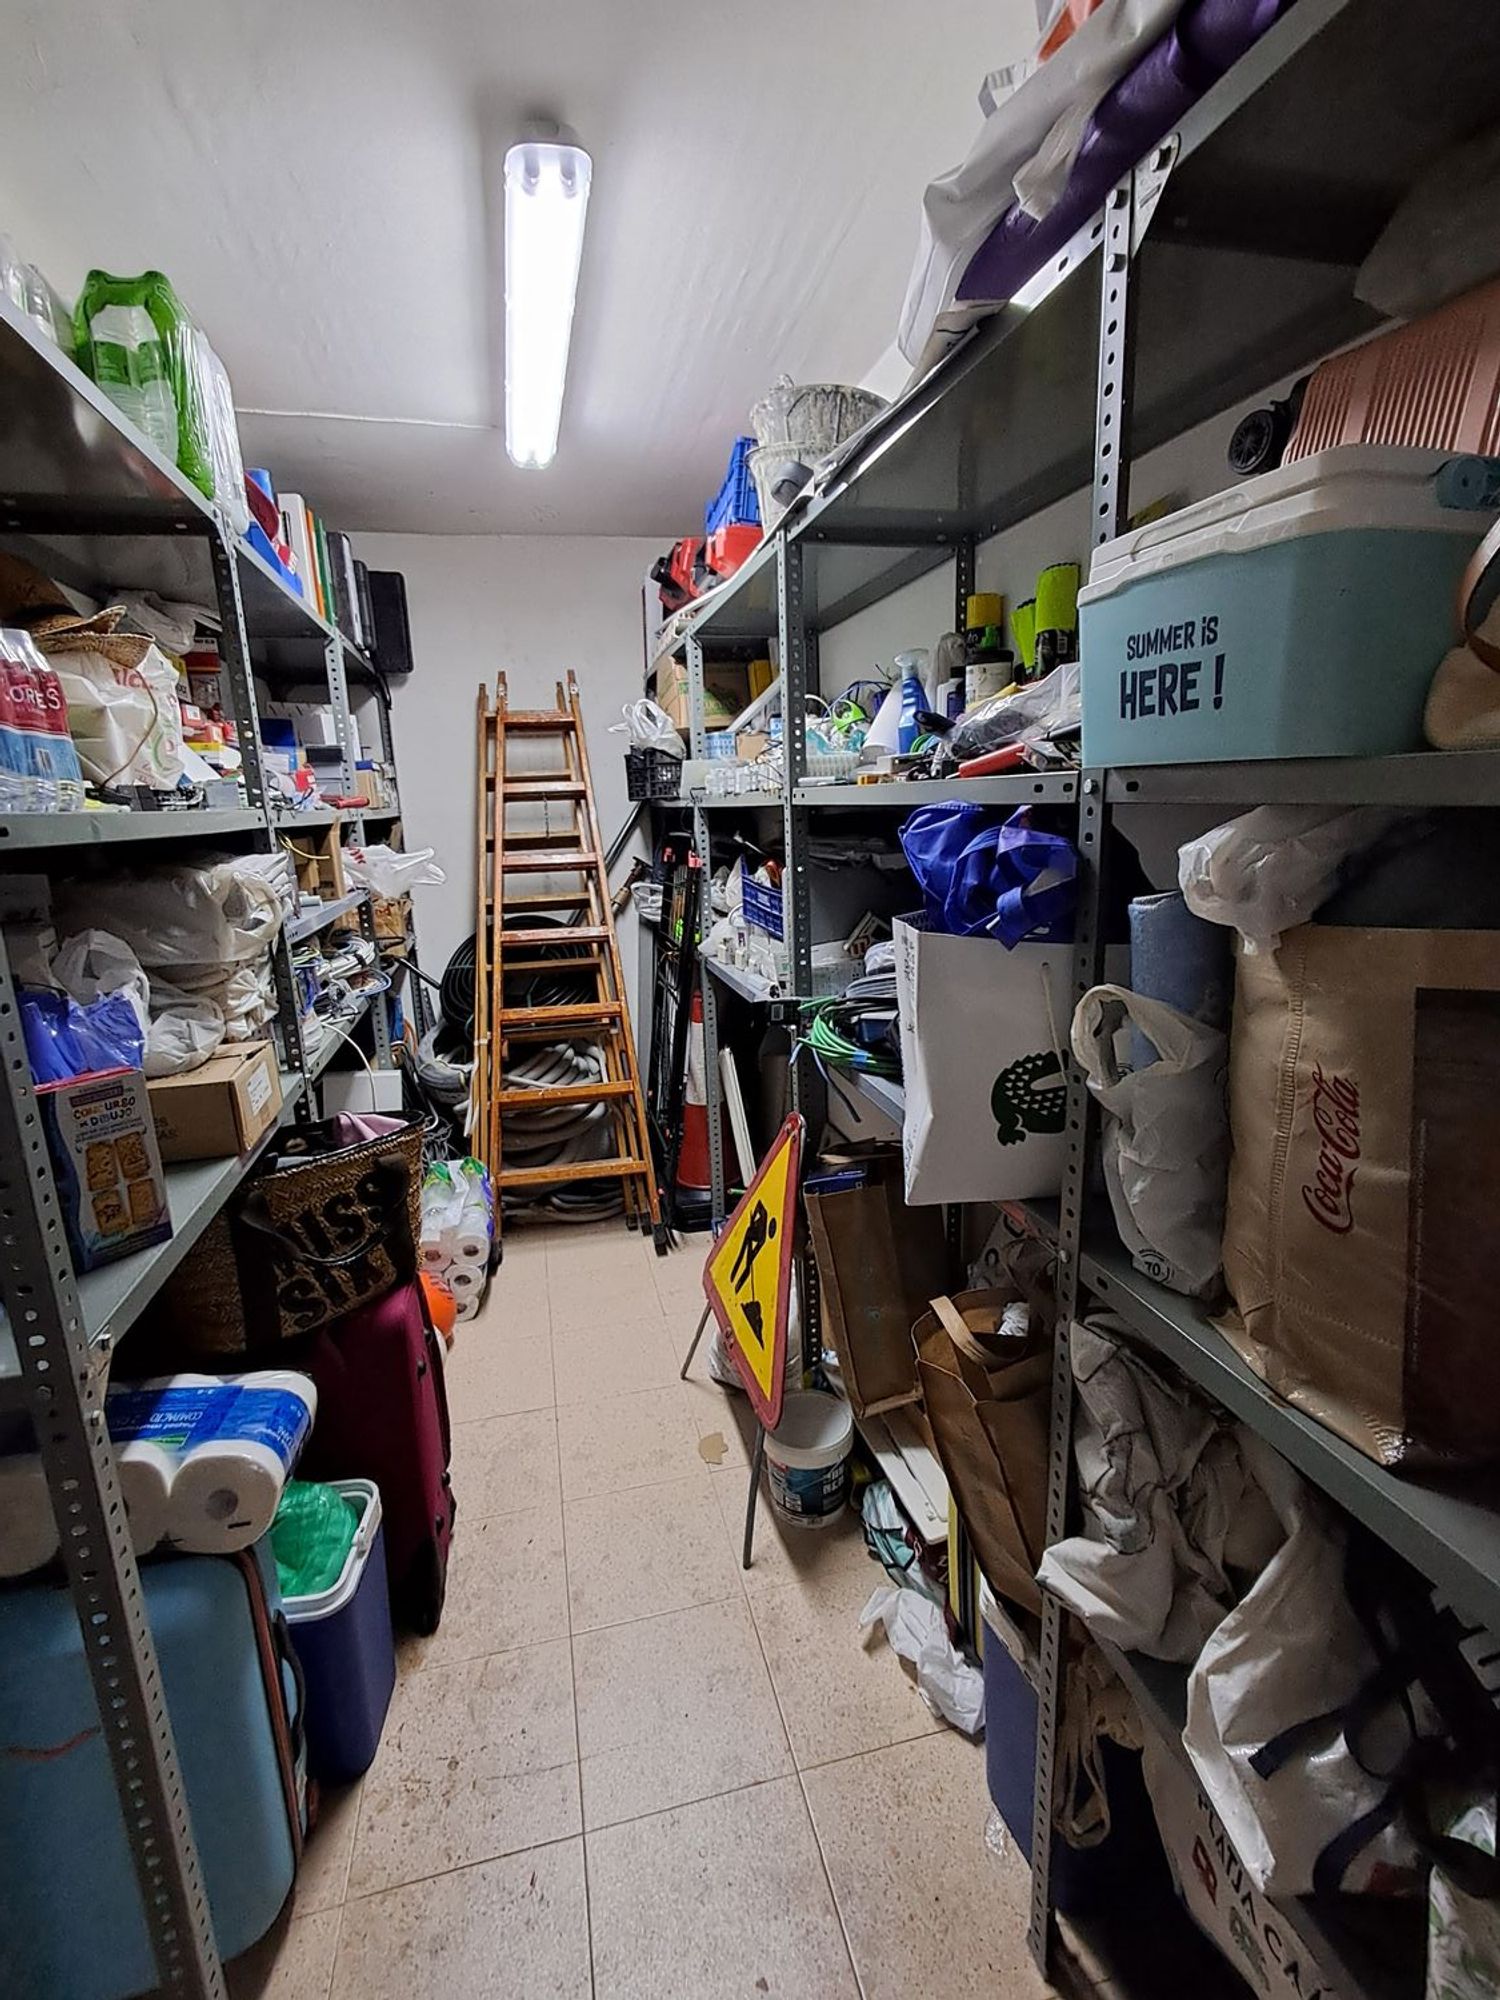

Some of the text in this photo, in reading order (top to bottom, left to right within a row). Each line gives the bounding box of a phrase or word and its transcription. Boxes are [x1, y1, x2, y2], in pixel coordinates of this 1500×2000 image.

[1126, 620, 1196, 661] SUMMER
[4, 685, 61, 710] ORES
[1120, 660, 1202, 720] HERE
[1301, 1059, 1361, 1235] Coca-Cola
[149, 1410, 204, 1424] COMPACTO
